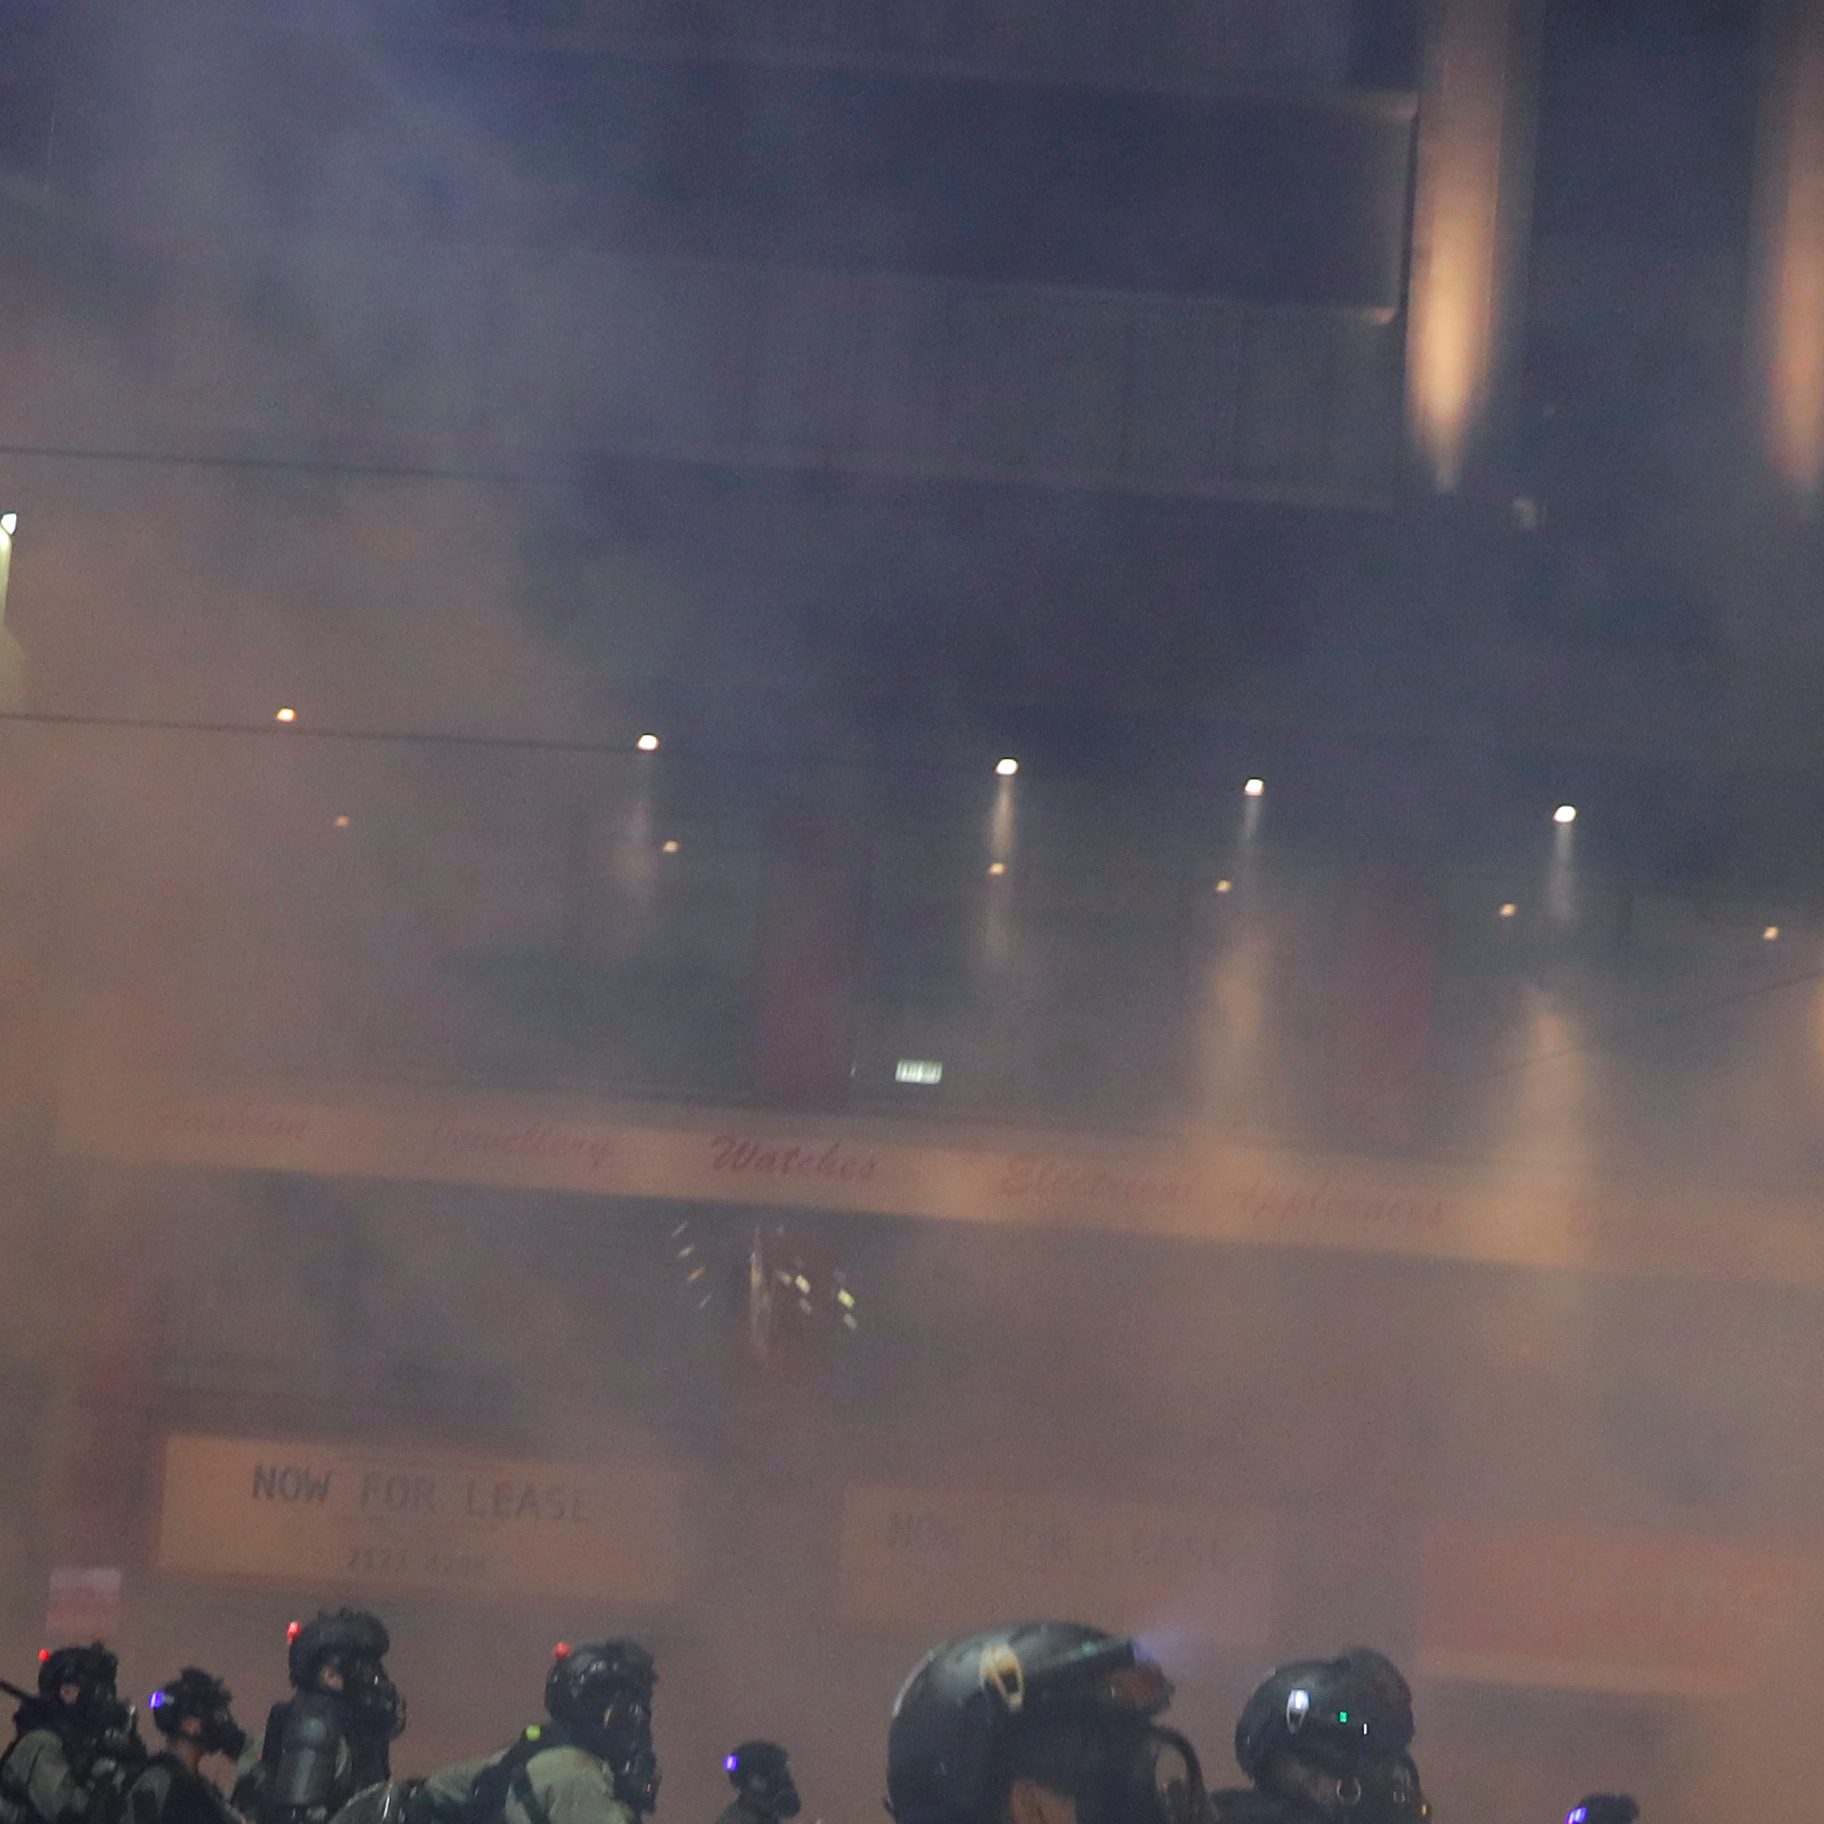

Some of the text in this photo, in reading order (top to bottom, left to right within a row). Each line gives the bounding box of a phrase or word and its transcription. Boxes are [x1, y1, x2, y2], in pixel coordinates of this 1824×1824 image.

[709, 1134, 879, 1183] Watches
[251, 1463, 591, 1523] NOW FOR LEASE
